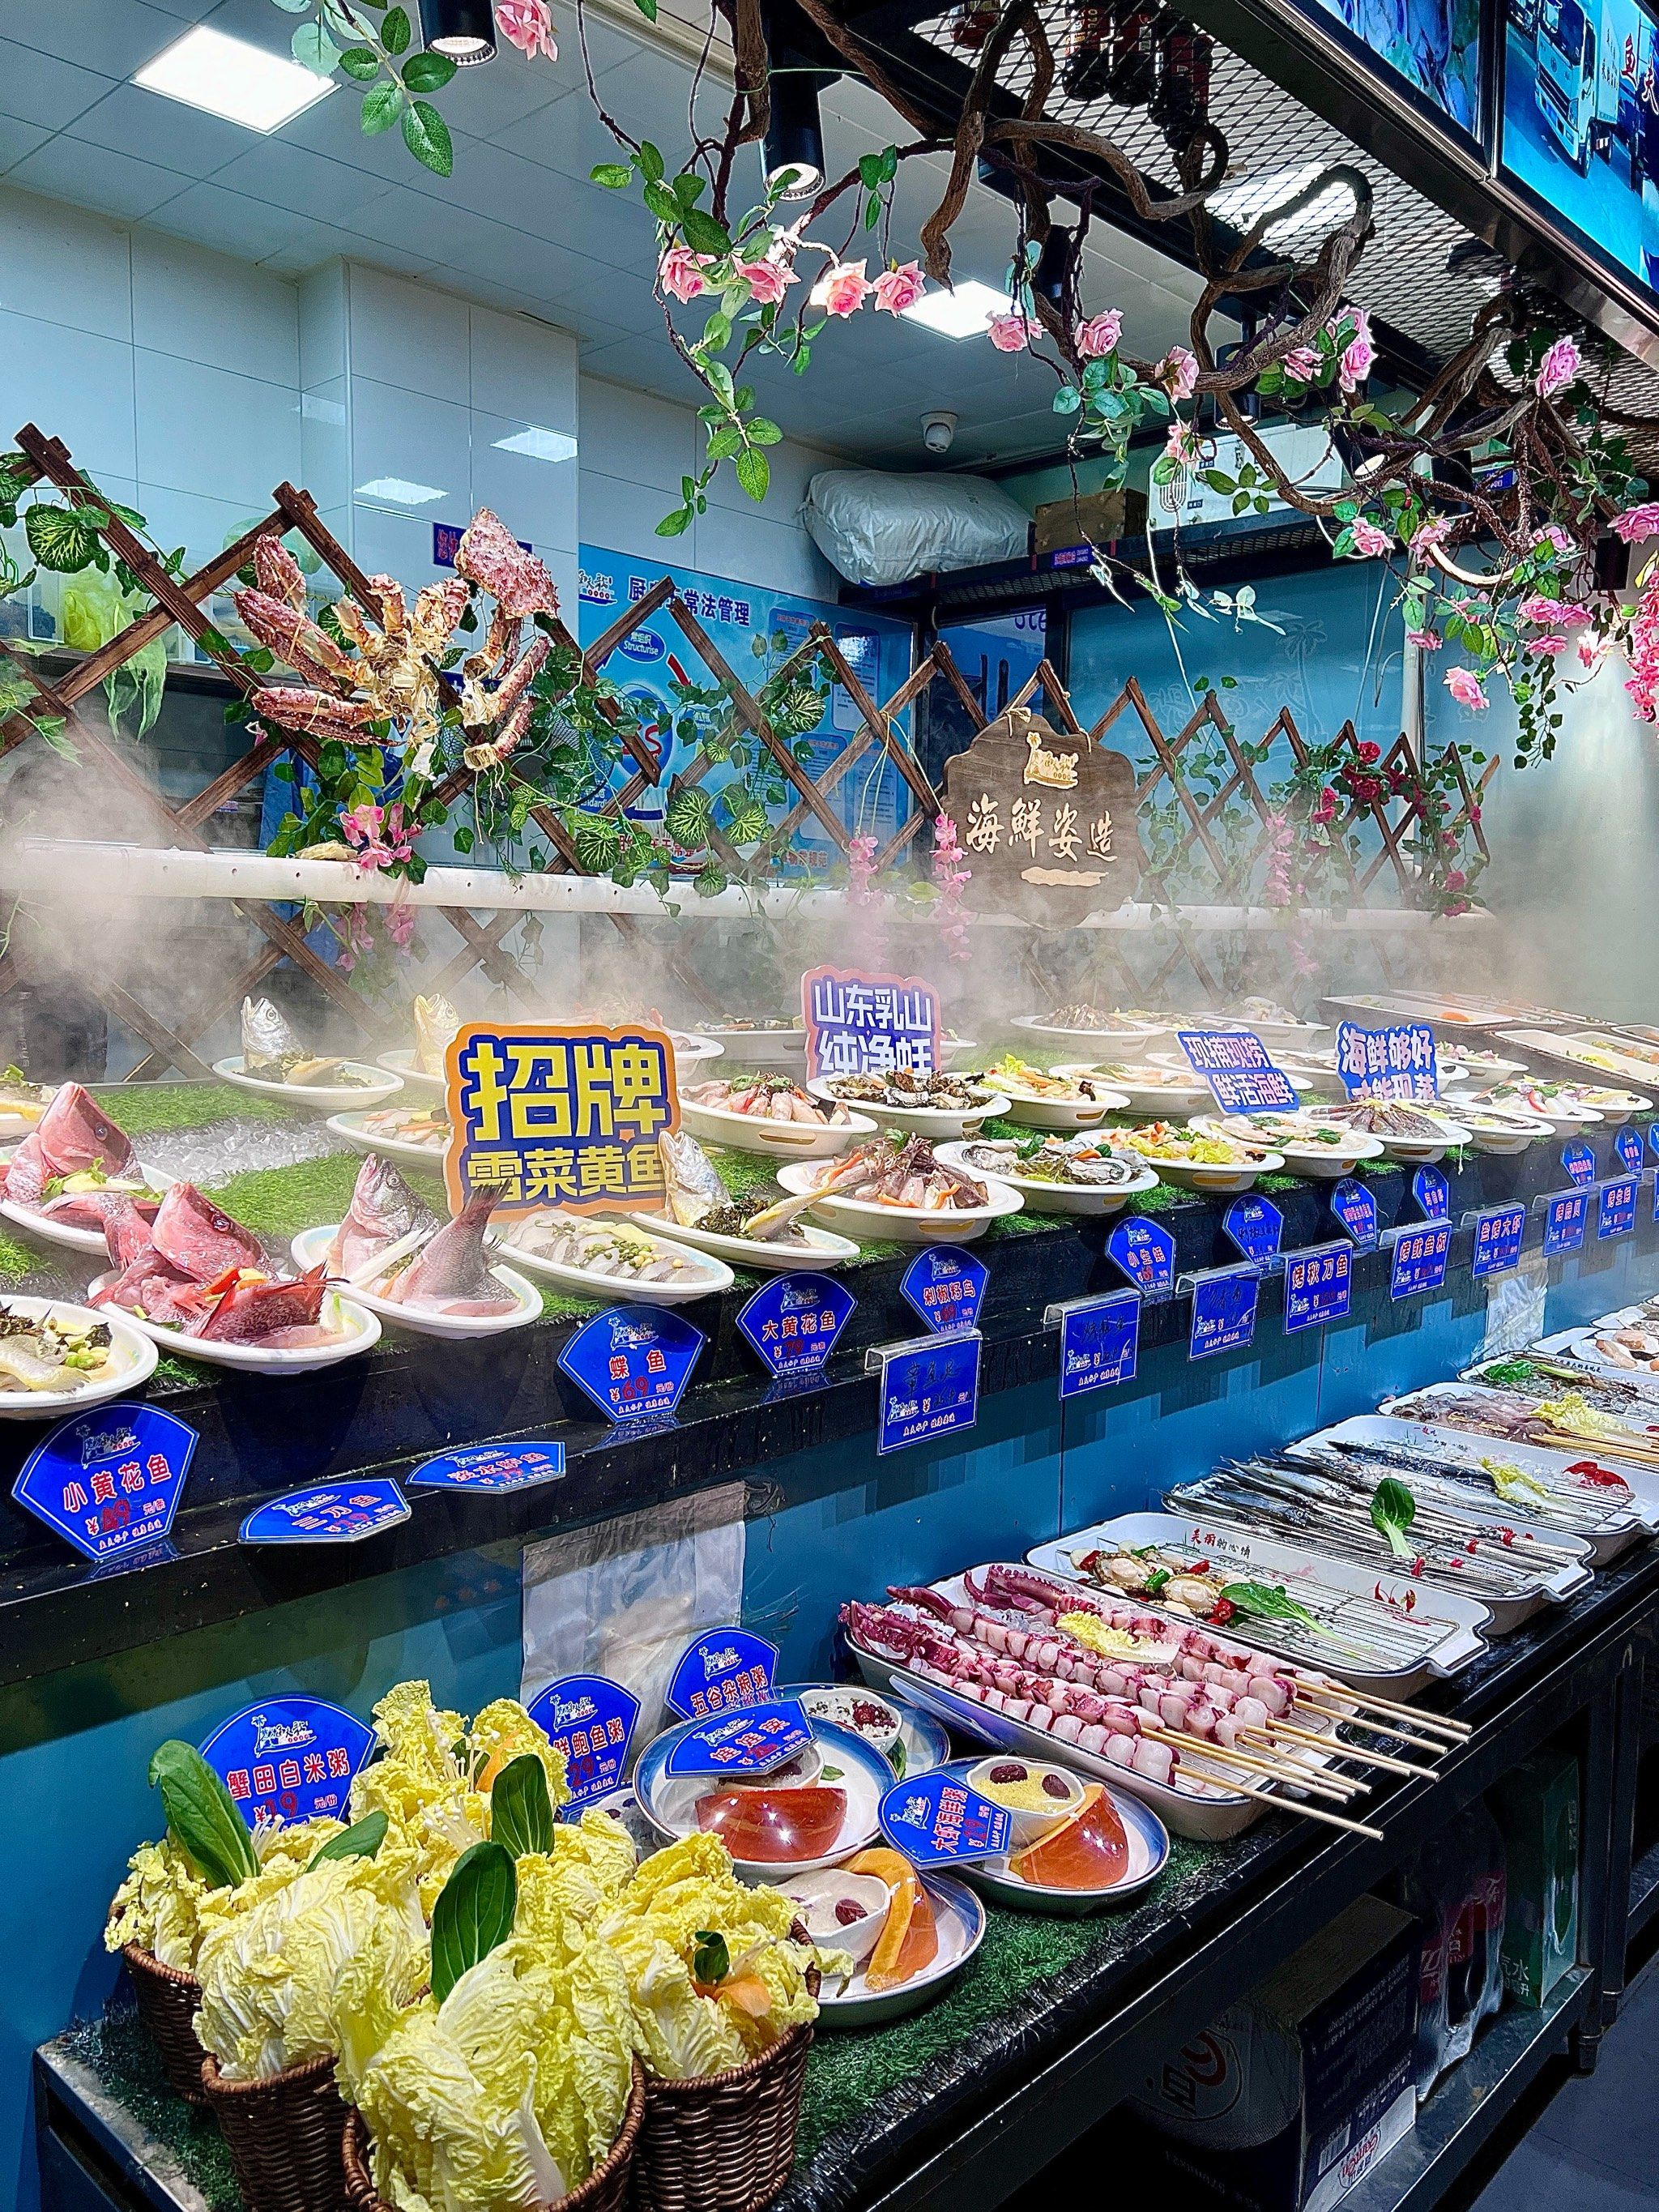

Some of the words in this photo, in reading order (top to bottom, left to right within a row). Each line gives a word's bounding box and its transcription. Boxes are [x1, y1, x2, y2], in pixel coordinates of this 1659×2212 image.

[628, 576, 750, 626] 厨常法管理
[815, 981, 932, 1031] 山东乳山
[467, 1042, 667, 1142] 招牌
[1212, 1073, 1294, 1106] 鲜活海鲜
[467, 1143, 667, 1202] 雪菜黄鱼
[1291, 1253, 1349, 1291] 烤秋刀鱼
[761, 1309, 836, 1343] 大黄花鱼
[63, 1454, 172, 1513] 小黄花鱼
[291, 1494, 382, 1531] 三刀鱼
[690, 1664, 769, 1718] 五谷杂粮粥
[227, 1747, 350, 1801] 蟹田白米粥
[313, 1793, 338, 1809] 元/份
